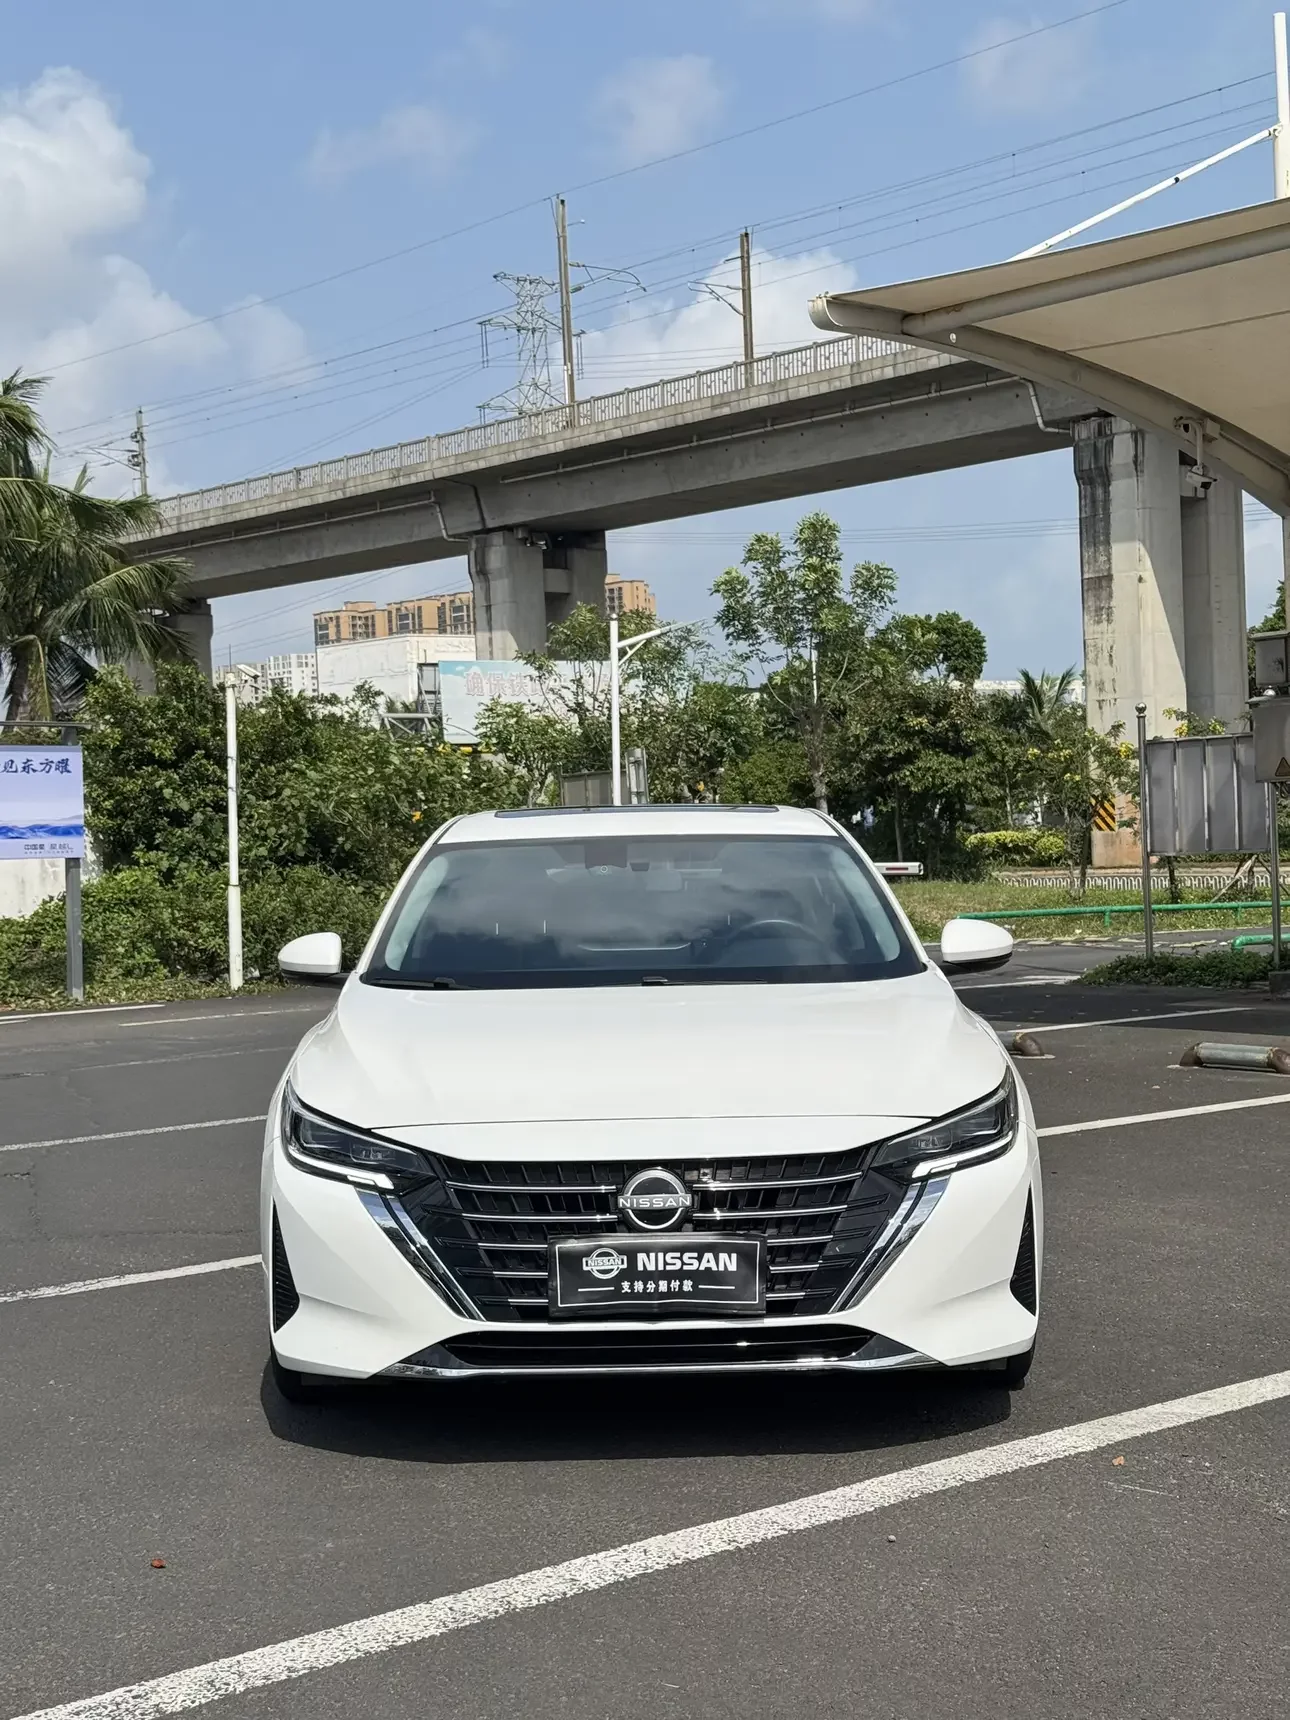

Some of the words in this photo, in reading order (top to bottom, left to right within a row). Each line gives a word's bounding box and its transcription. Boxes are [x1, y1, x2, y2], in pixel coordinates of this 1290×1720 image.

[619, 1196, 690, 1208] NISSAN
[587, 1259, 622, 1267] NISSAN
[637, 1252, 738, 1272] NISSAN
[621, 1280, 694, 1293] 支持分期付款
